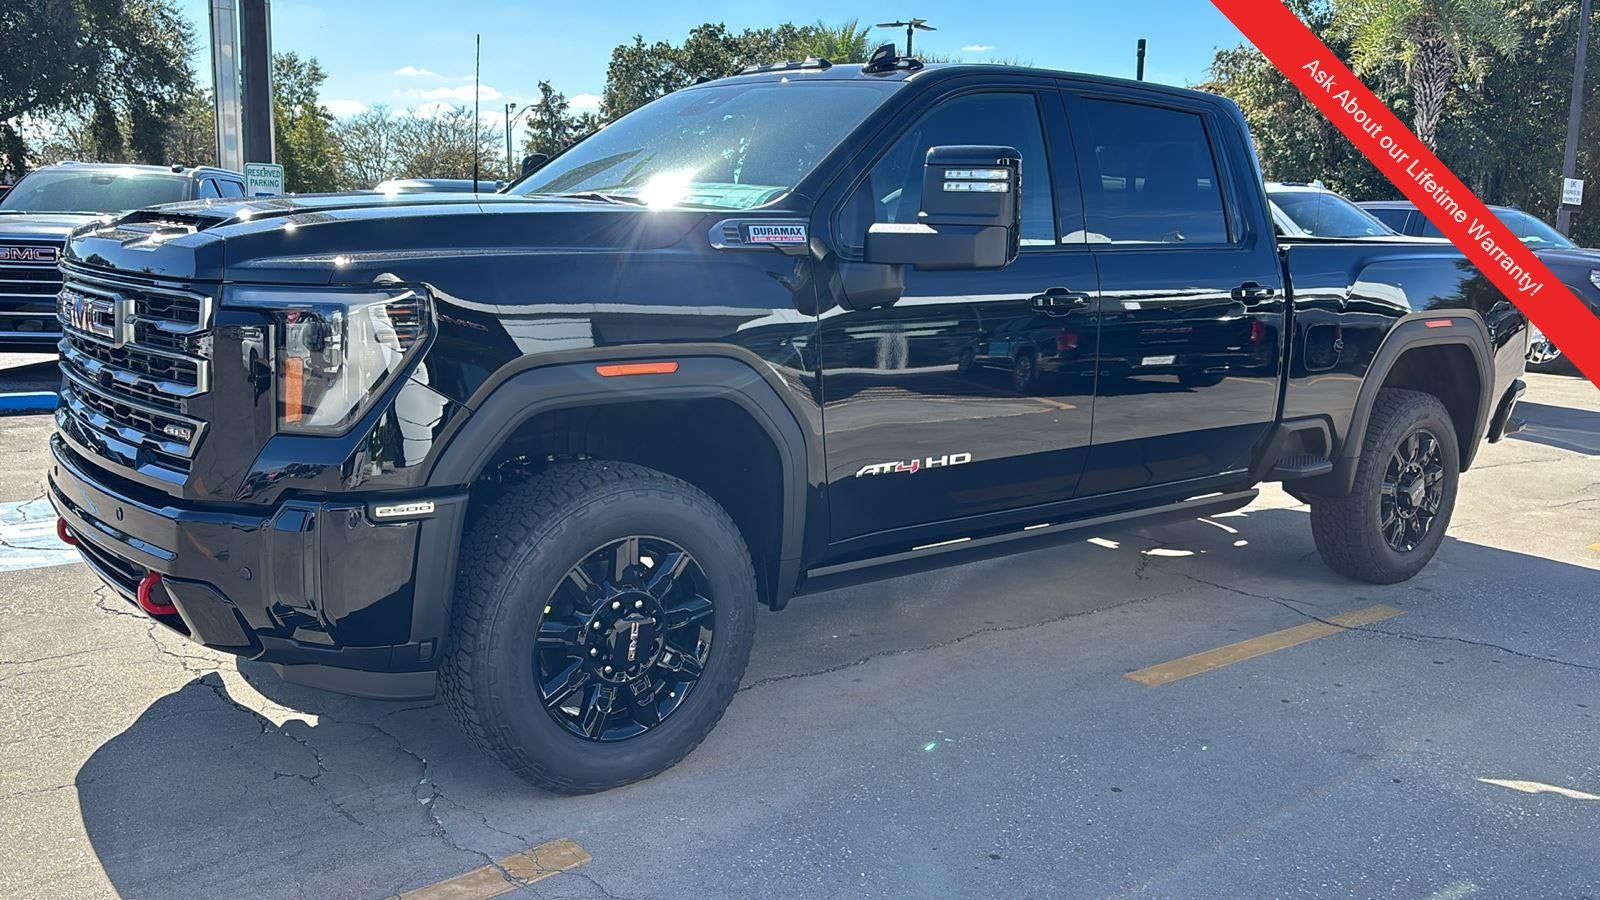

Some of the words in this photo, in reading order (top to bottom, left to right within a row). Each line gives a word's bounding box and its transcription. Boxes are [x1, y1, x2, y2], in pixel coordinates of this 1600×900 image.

[247, 169, 281, 178] RESERVED
[250, 179, 280, 188] PARKING
[752, 227, 803, 236] DURAMAX
[60, 290, 115, 338] GMC
[856, 459, 920, 478] AT4
[926, 452, 972, 469] HD
[378, 504, 432, 514] 2500
